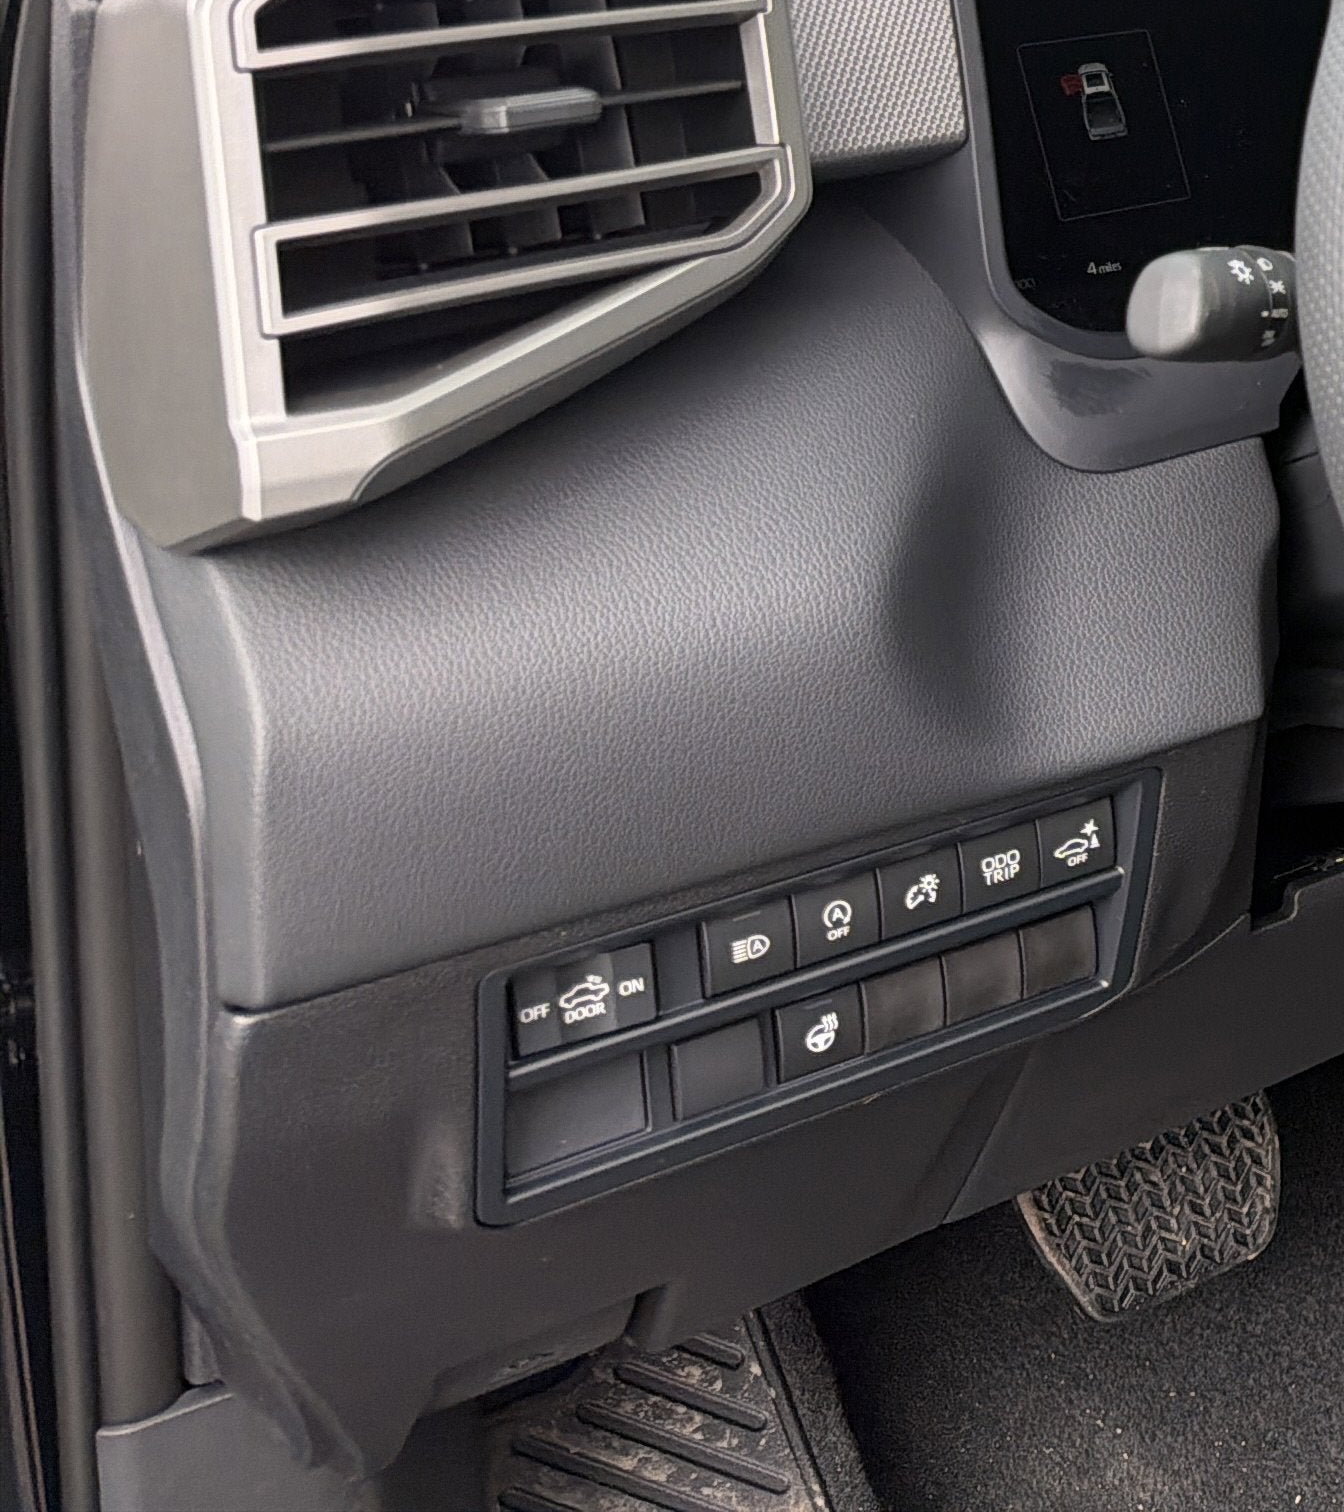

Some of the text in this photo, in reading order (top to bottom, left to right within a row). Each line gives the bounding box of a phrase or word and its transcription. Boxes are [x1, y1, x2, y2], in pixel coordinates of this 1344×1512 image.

[1086, 261, 1123, 275] 4 miles
[981, 849, 1020, 872] ODO
[1067, 852, 1089, 867] OFF
[983, 863, 1020, 886] TRIP
[826, 926, 850, 941] OFF
[618, 976, 645, 996] ON
[520, 1002, 550, 1024] OFF
[564, 1002, 606, 1025] DOOR
